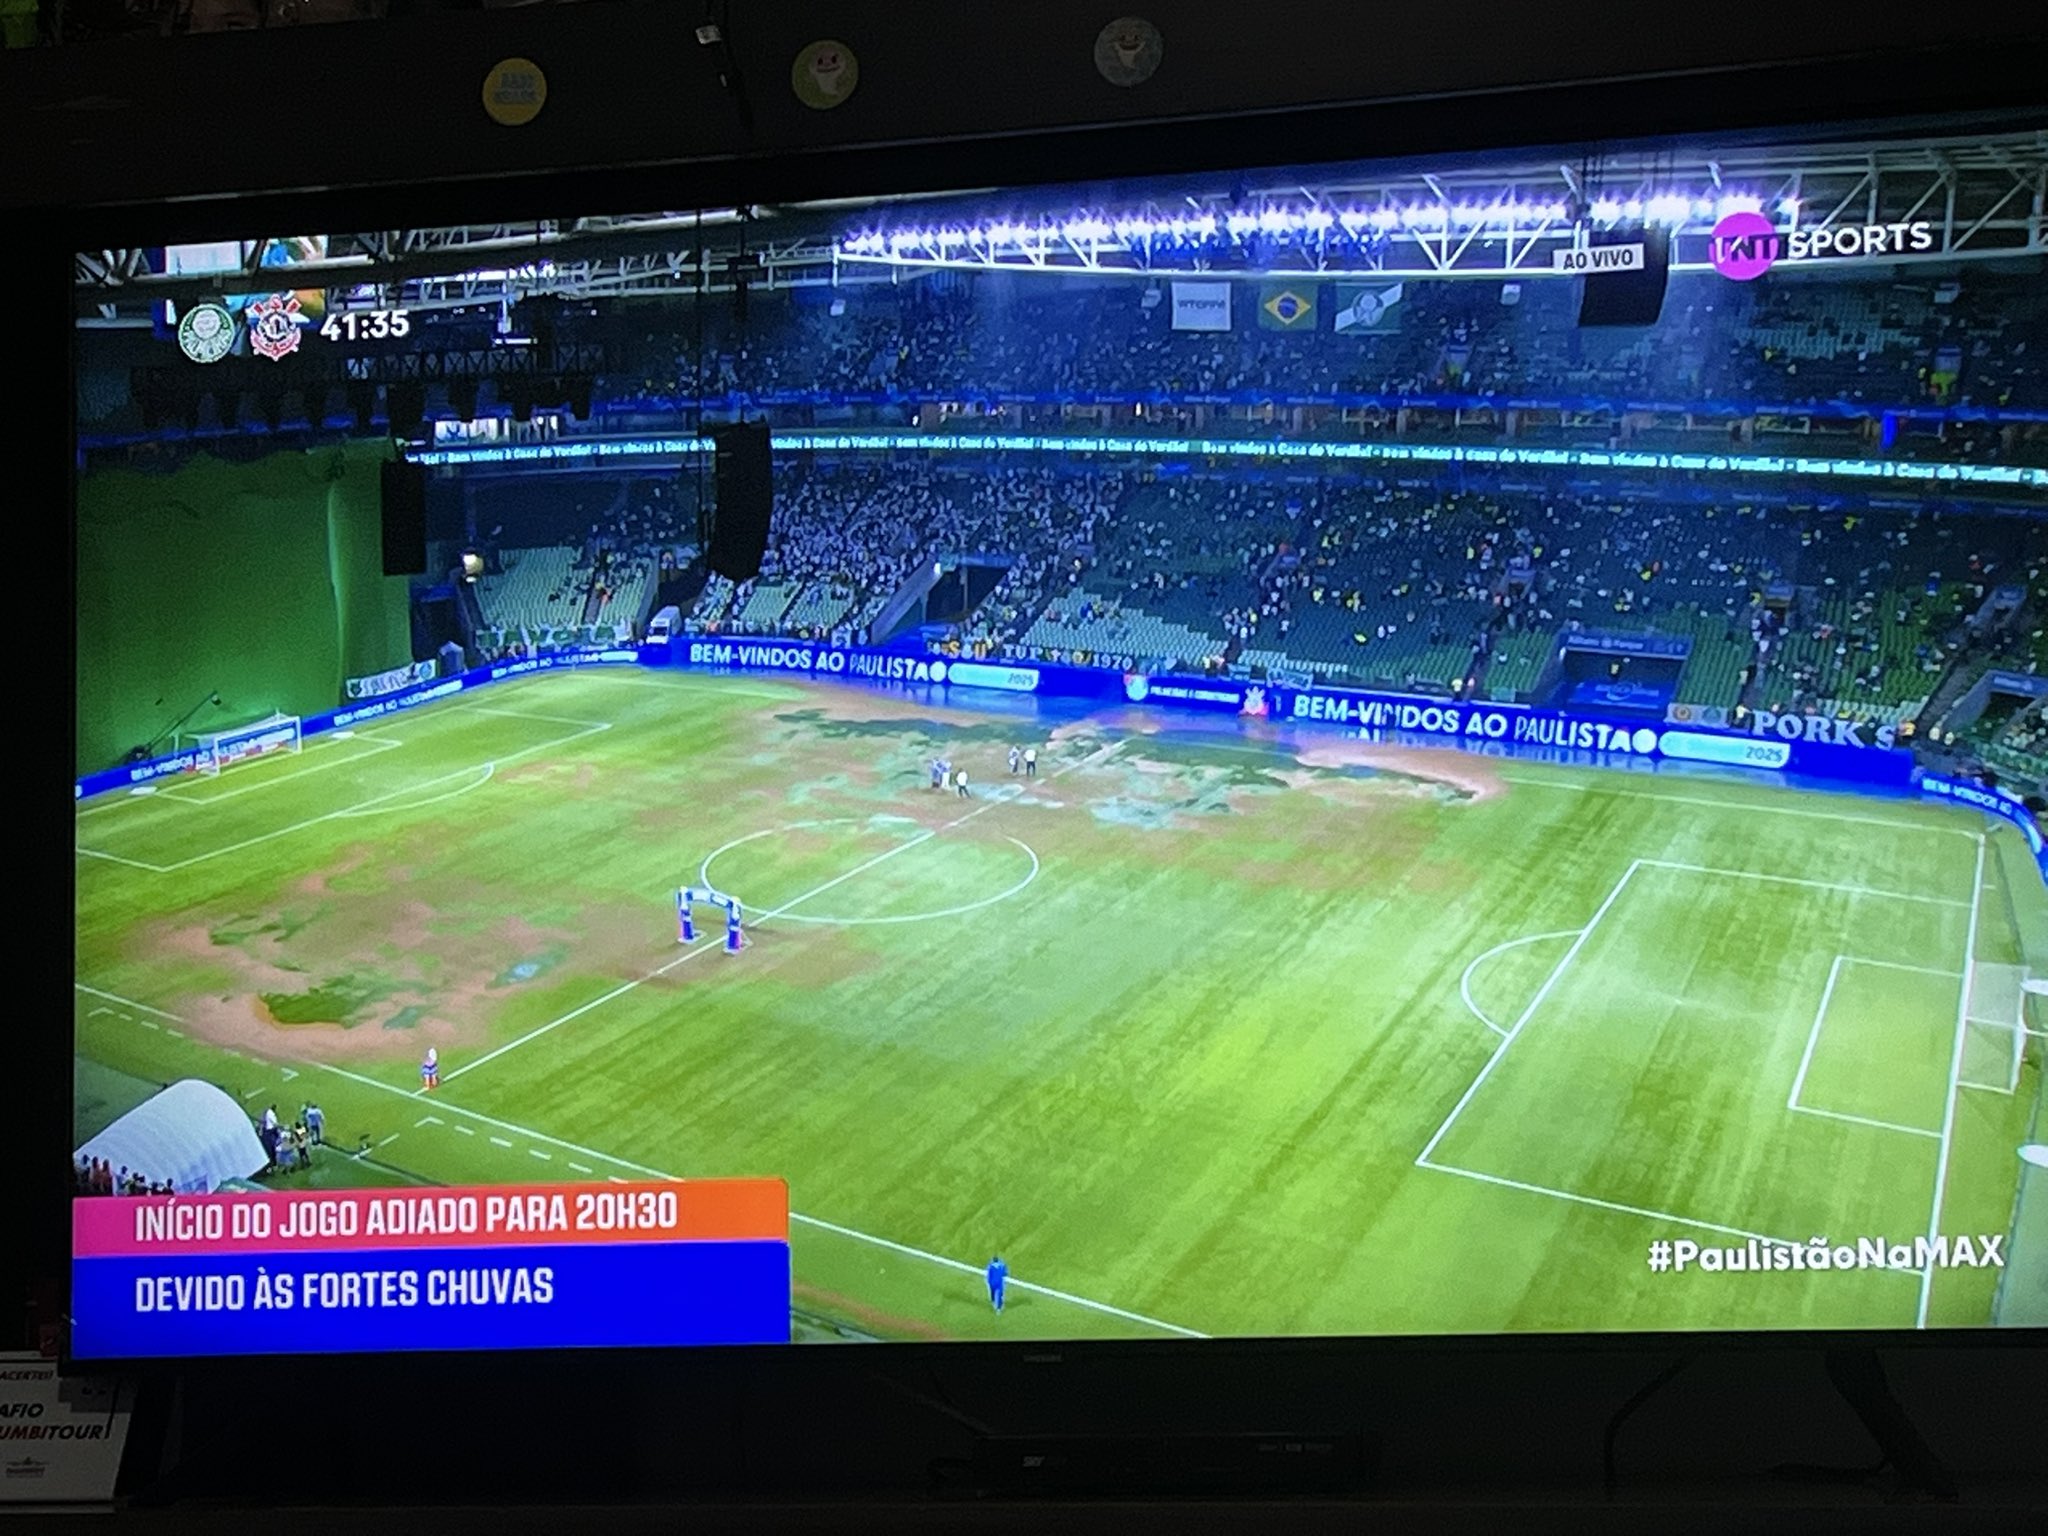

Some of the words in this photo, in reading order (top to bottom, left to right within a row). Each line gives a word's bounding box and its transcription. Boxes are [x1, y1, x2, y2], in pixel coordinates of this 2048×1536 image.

[1563, 253, 1588, 270] AO
[1592, 248, 1634, 267] VIVO
[1788, 222, 1932, 259] SPORTS
[321, 309, 410, 341] 41:35
[689, 643, 812, 670] BEM-VINDOS
[815, 651, 845, 672] AO
[1293, 694, 1460, 733] BEM-VINDOS
[1465, 711, 1508, 738] AO
[135, 1197, 223, 1241] INÍCIO
[231, 1202, 271, 1239] DO
[279, 1200, 358, 1238] JOGO
[365, 1196, 477, 1236] ADIADO
[485, 1194, 568, 1232] PARA
[575, 1191, 678, 1231] 20H30
[1648, 1234, 2005, 1272] #PaulistãoNaMAX
[135, 1275, 245, 1312] DEVIDO
[253, 1266, 294, 1310] ÀS
[302, 1271, 418, 1308] FORTES
[427, 1267, 554, 1307] CHUVAS
